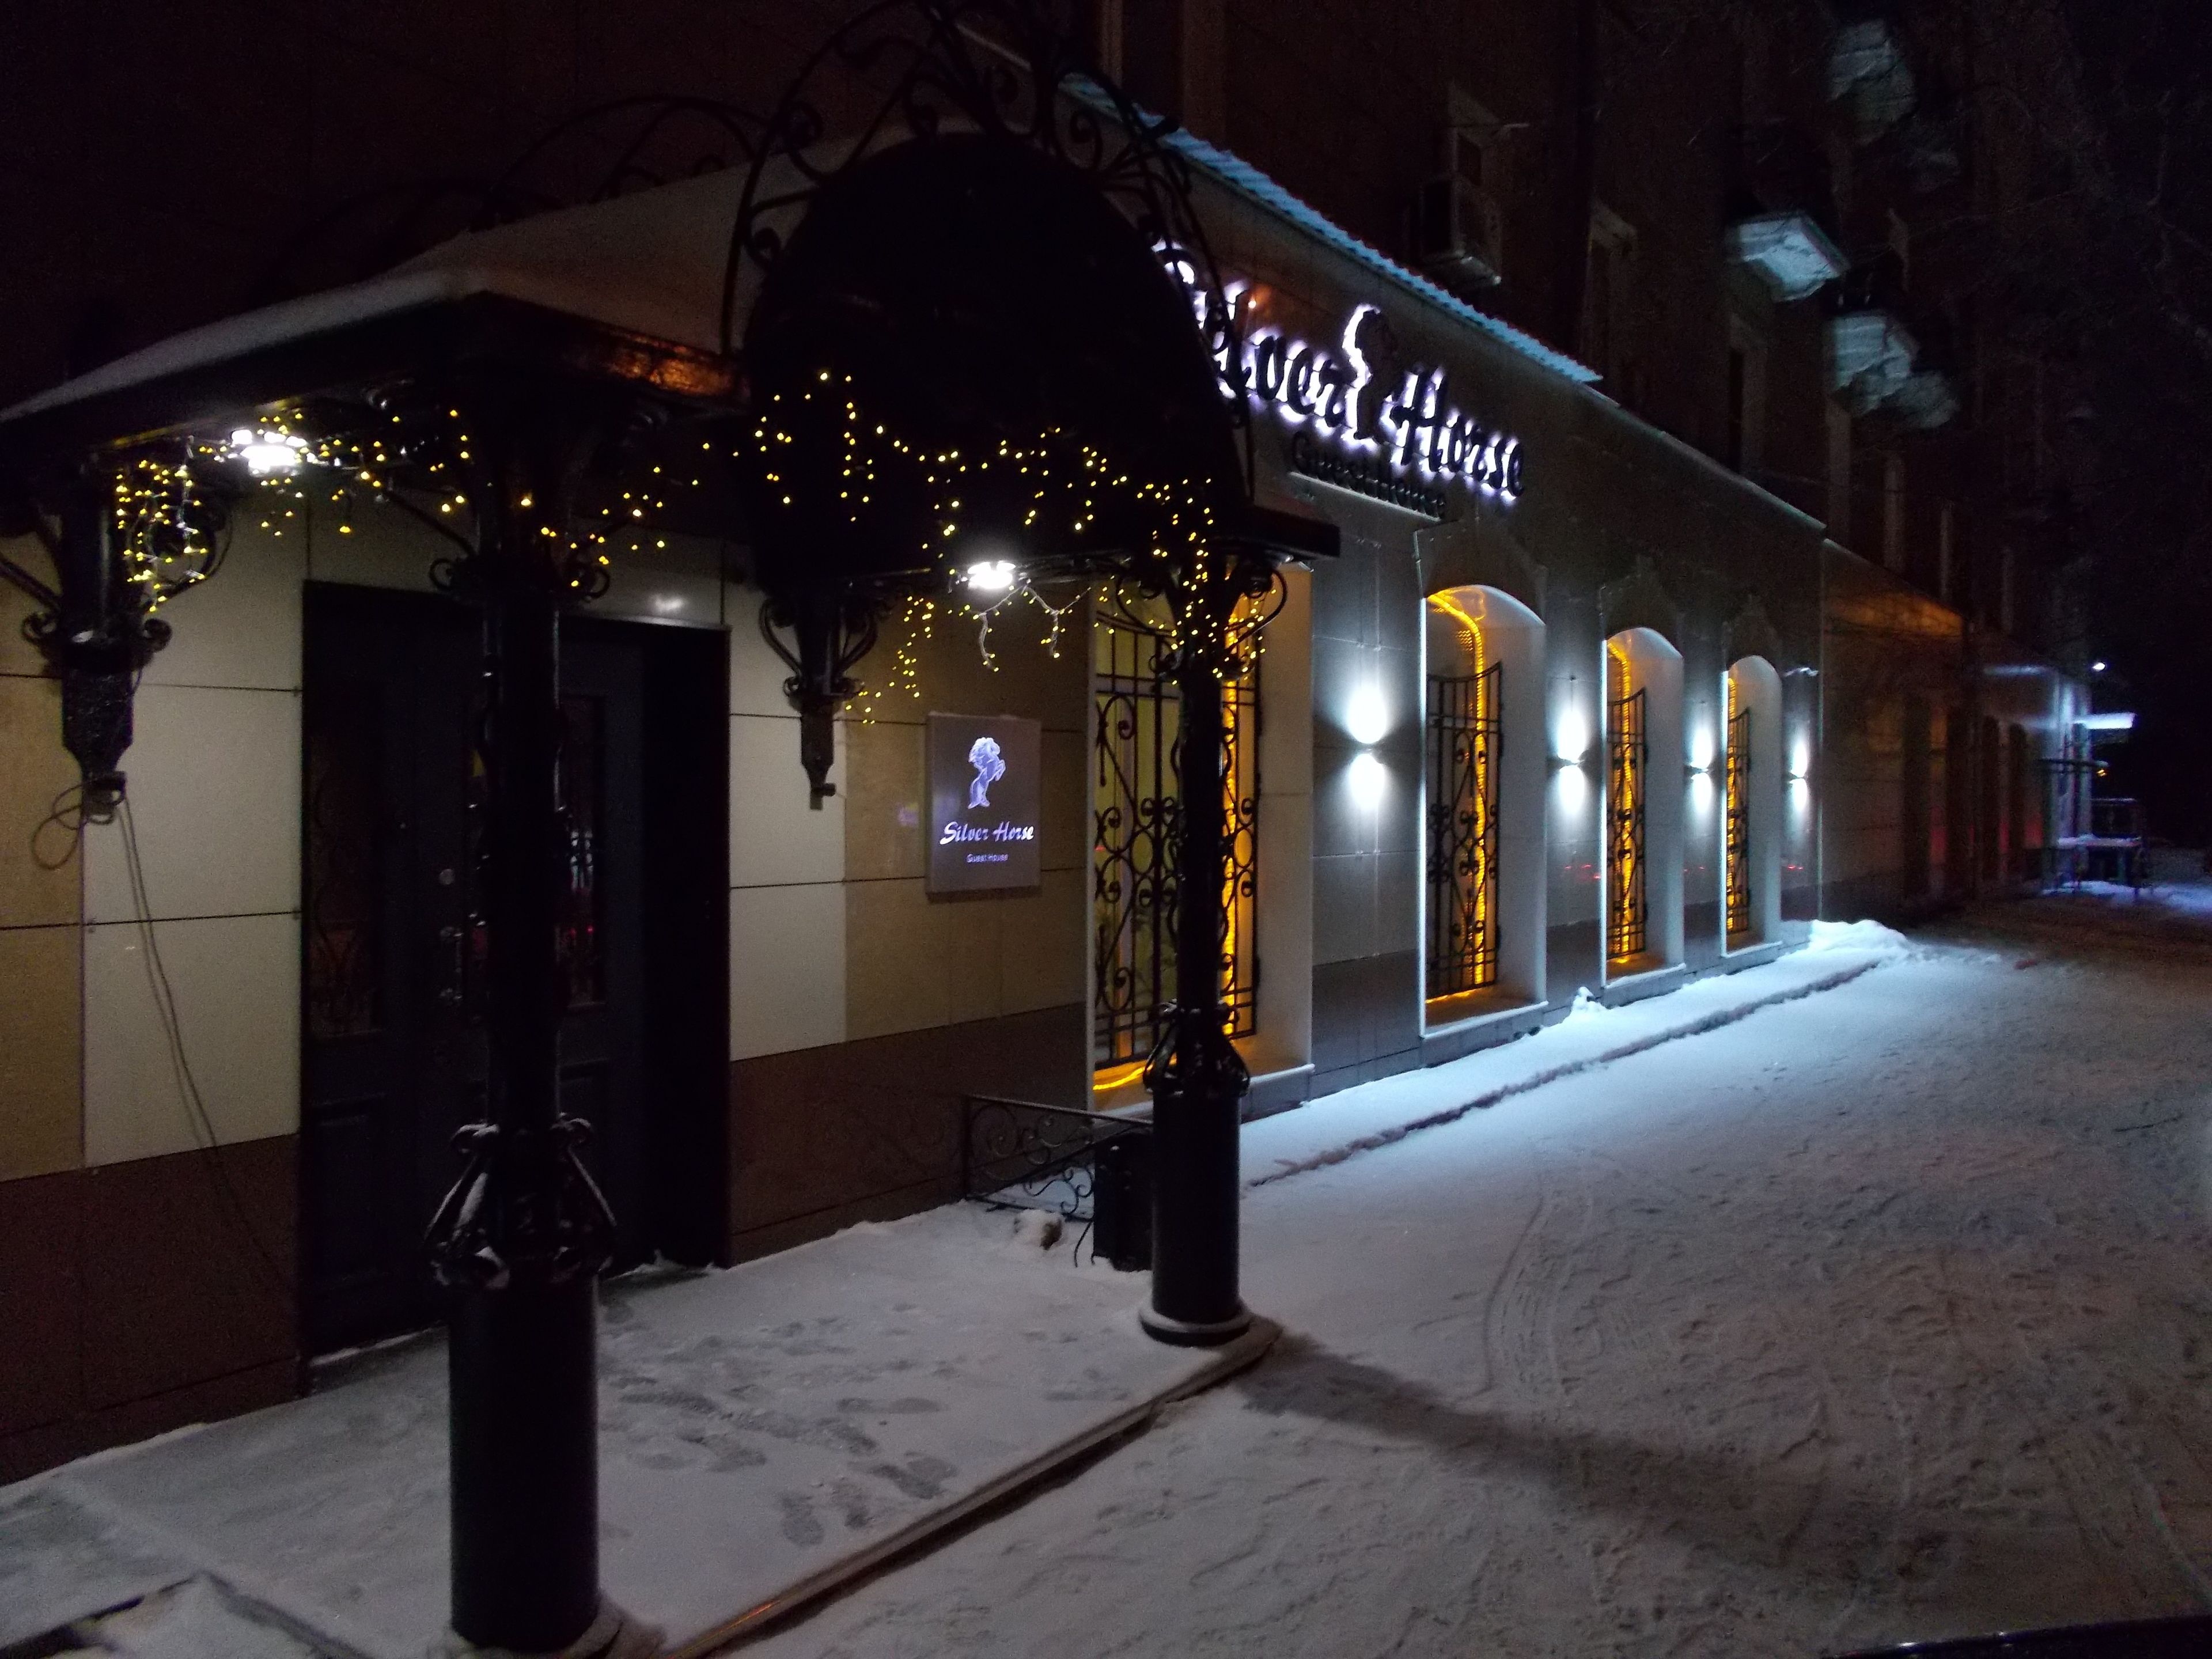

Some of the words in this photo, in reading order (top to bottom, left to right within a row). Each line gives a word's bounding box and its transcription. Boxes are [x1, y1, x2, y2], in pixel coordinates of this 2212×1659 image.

[1388, 368, 1524, 497] Horse
[940, 821, 988, 845] Silver
[993, 820, 1035, 842] Horse
